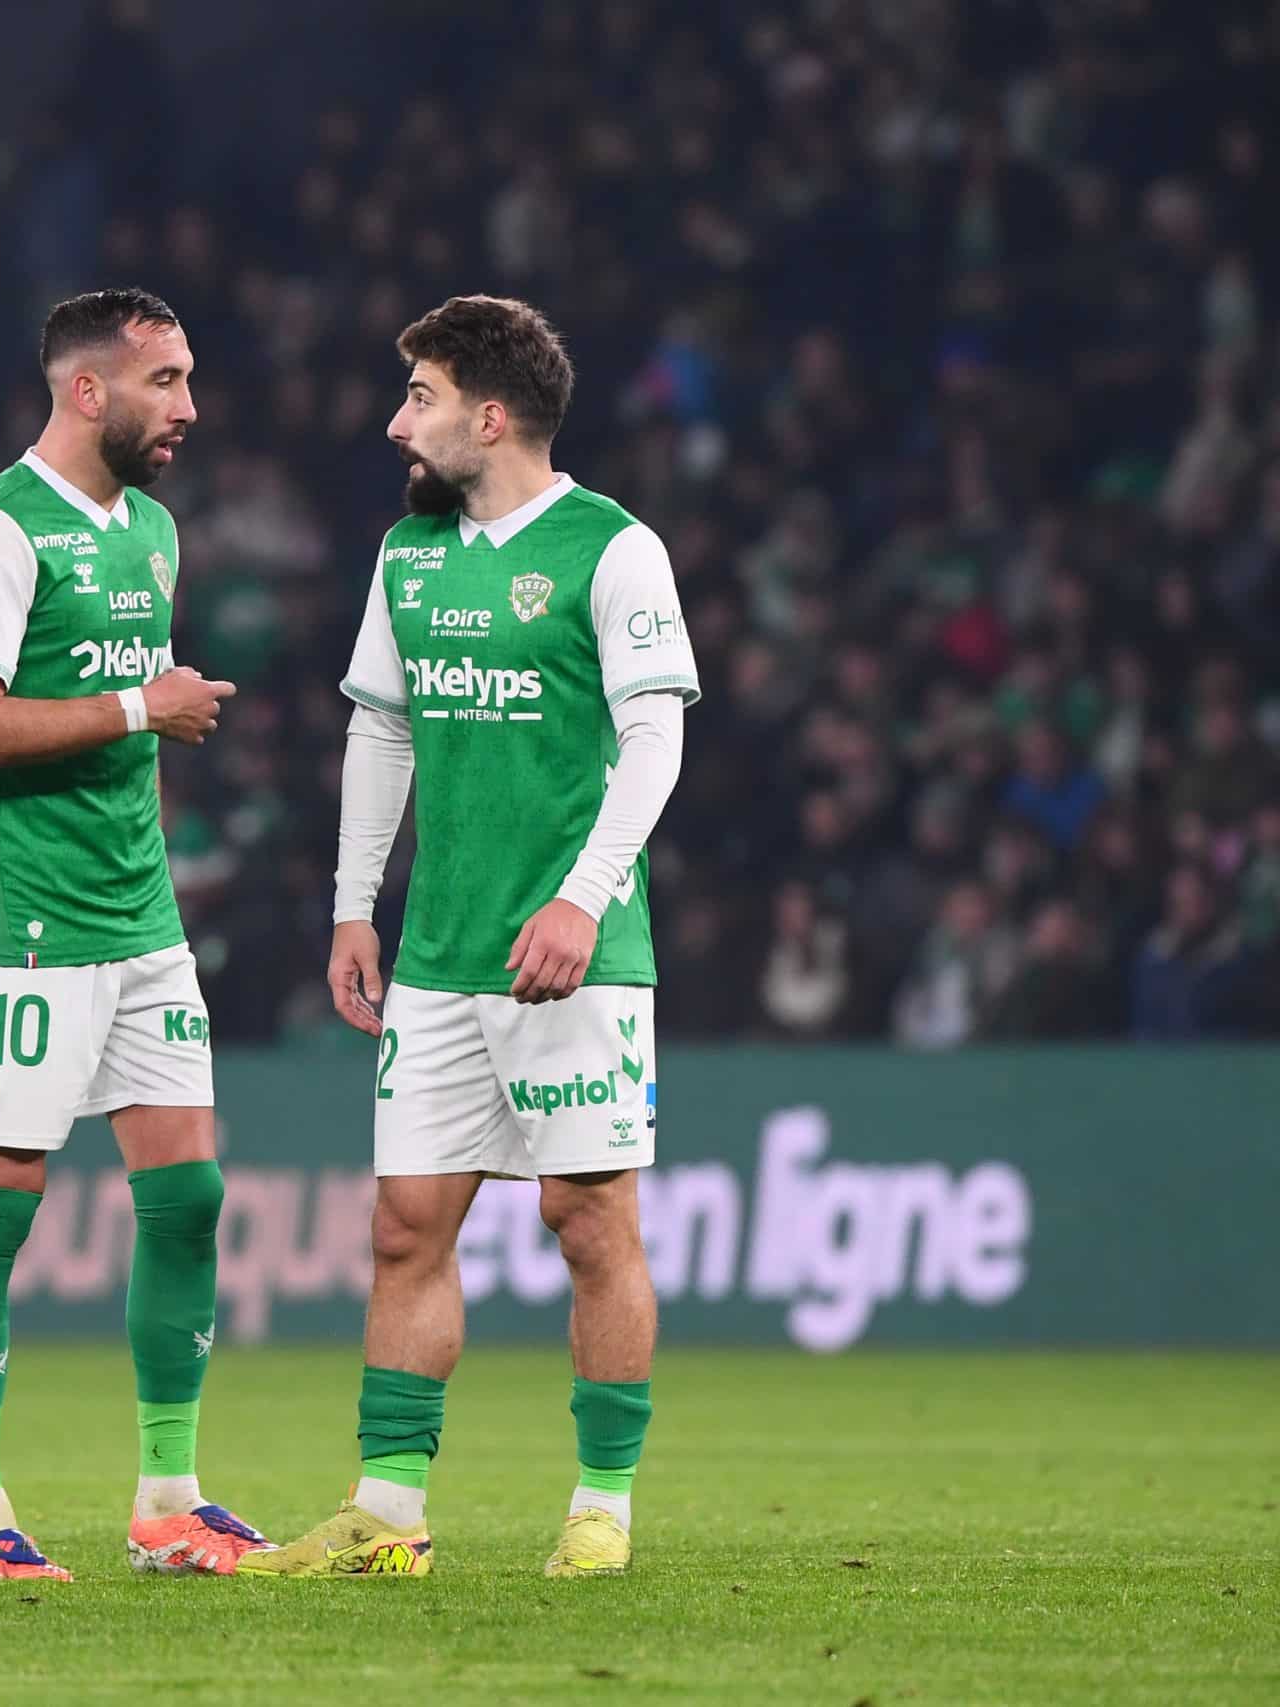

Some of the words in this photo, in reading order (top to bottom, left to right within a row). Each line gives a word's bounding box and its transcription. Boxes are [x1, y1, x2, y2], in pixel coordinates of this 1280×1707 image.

[414, 560, 443, 570] LOIRE
[108, 590, 152, 610] Loire
[431, 607, 493, 628] Loire
[430, 629, 438, 637] LE
[103, 635, 175, 686] Kely
[419, 656, 543, 708] Kelyps
[454, 708, 503, 723] INTERIM
[508, 1070, 618, 1117] Kapriol
[748, 1108, 1034, 1352] ligne
